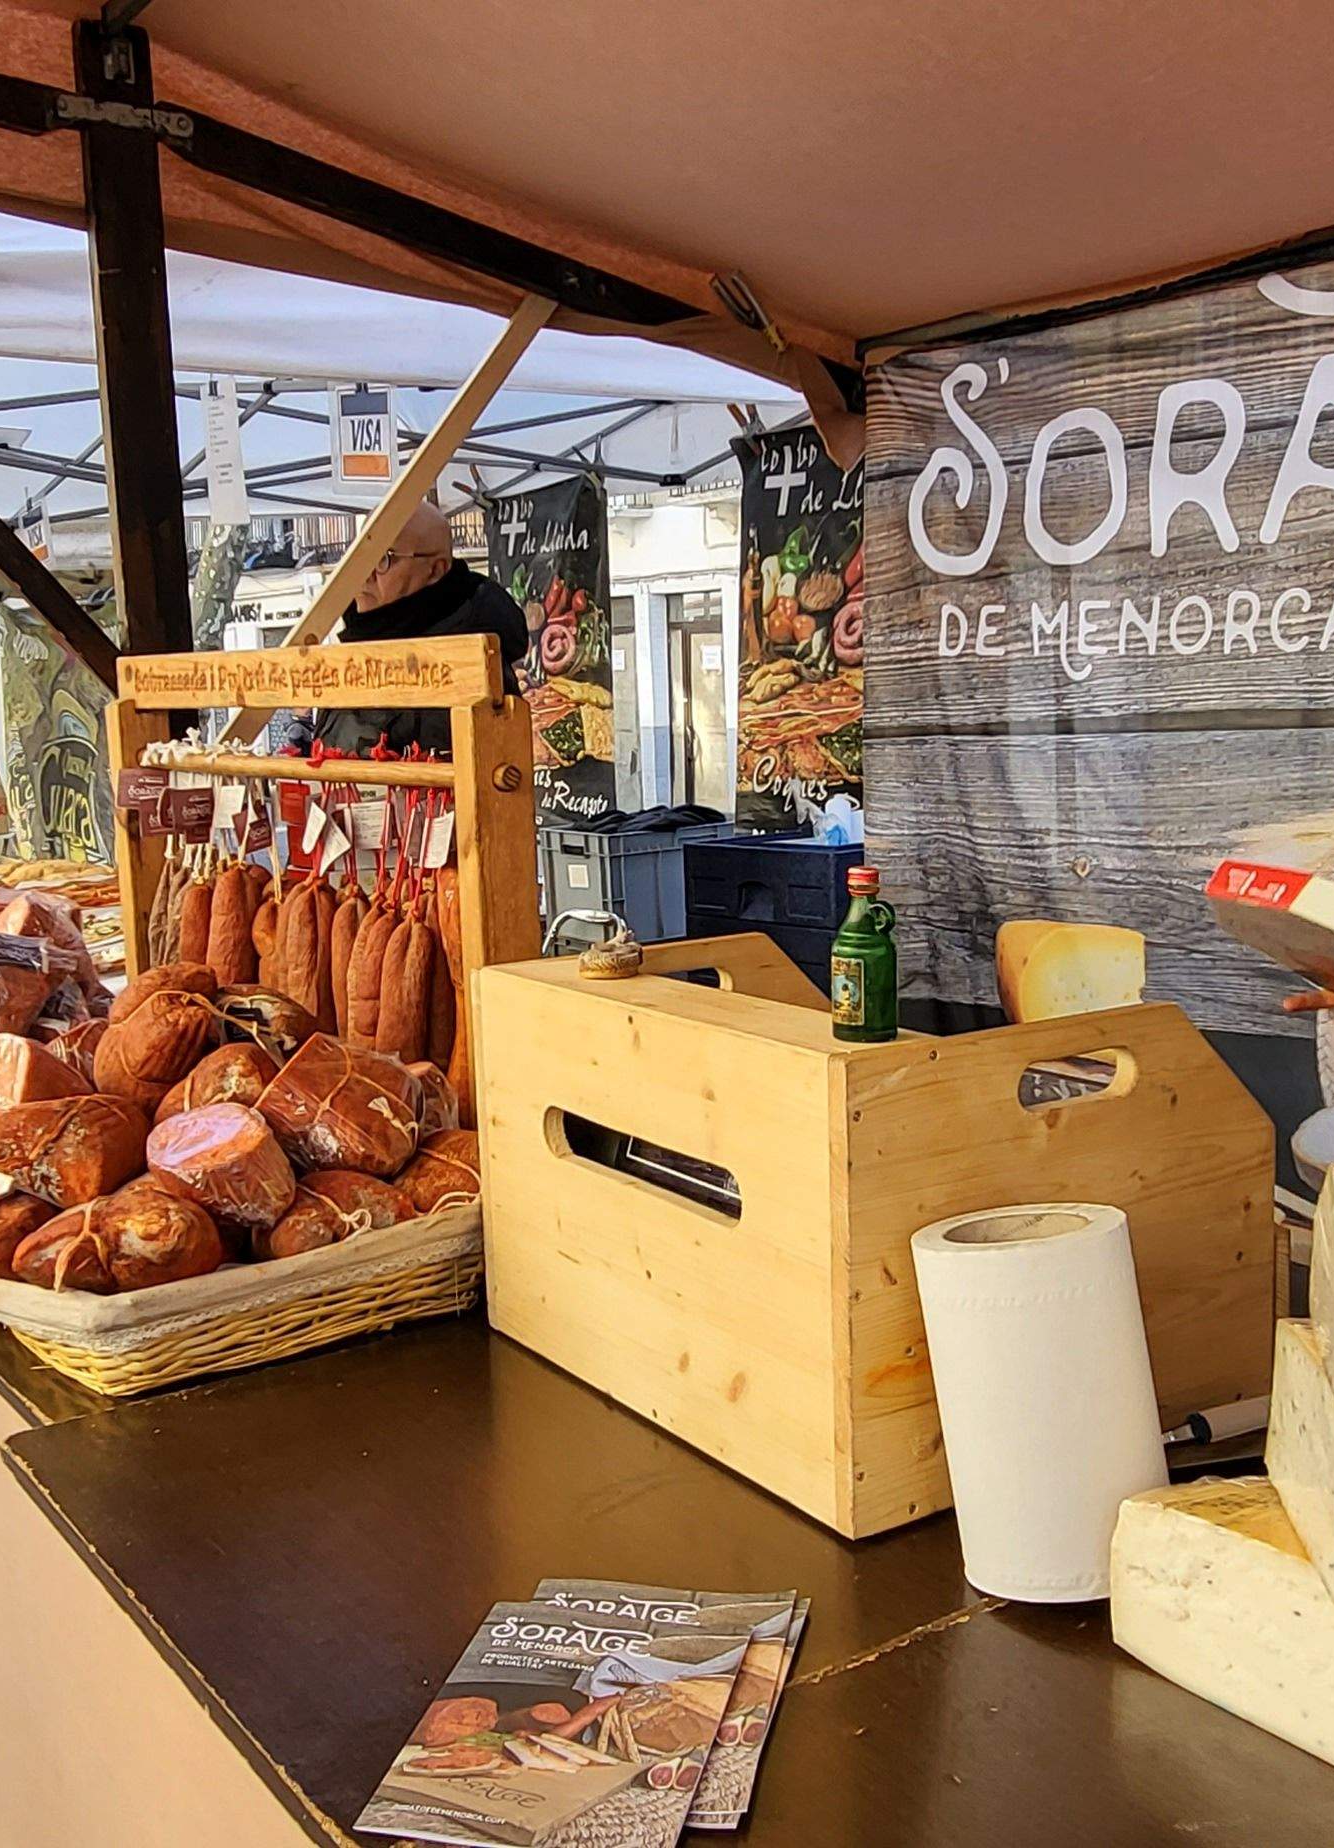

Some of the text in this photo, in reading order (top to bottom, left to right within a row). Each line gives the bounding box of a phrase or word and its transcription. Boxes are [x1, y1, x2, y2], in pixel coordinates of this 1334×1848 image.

[350, 418, 382, 452] VISA
[799, 480, 824, 515] de
[520, 520, 590, 556] de Lleida
[939, 600, 1007, 658] DE
[490, 1616, 654, 1658] S'ORATGE
[491, 1639, 582, 1656] DE MENORCA
